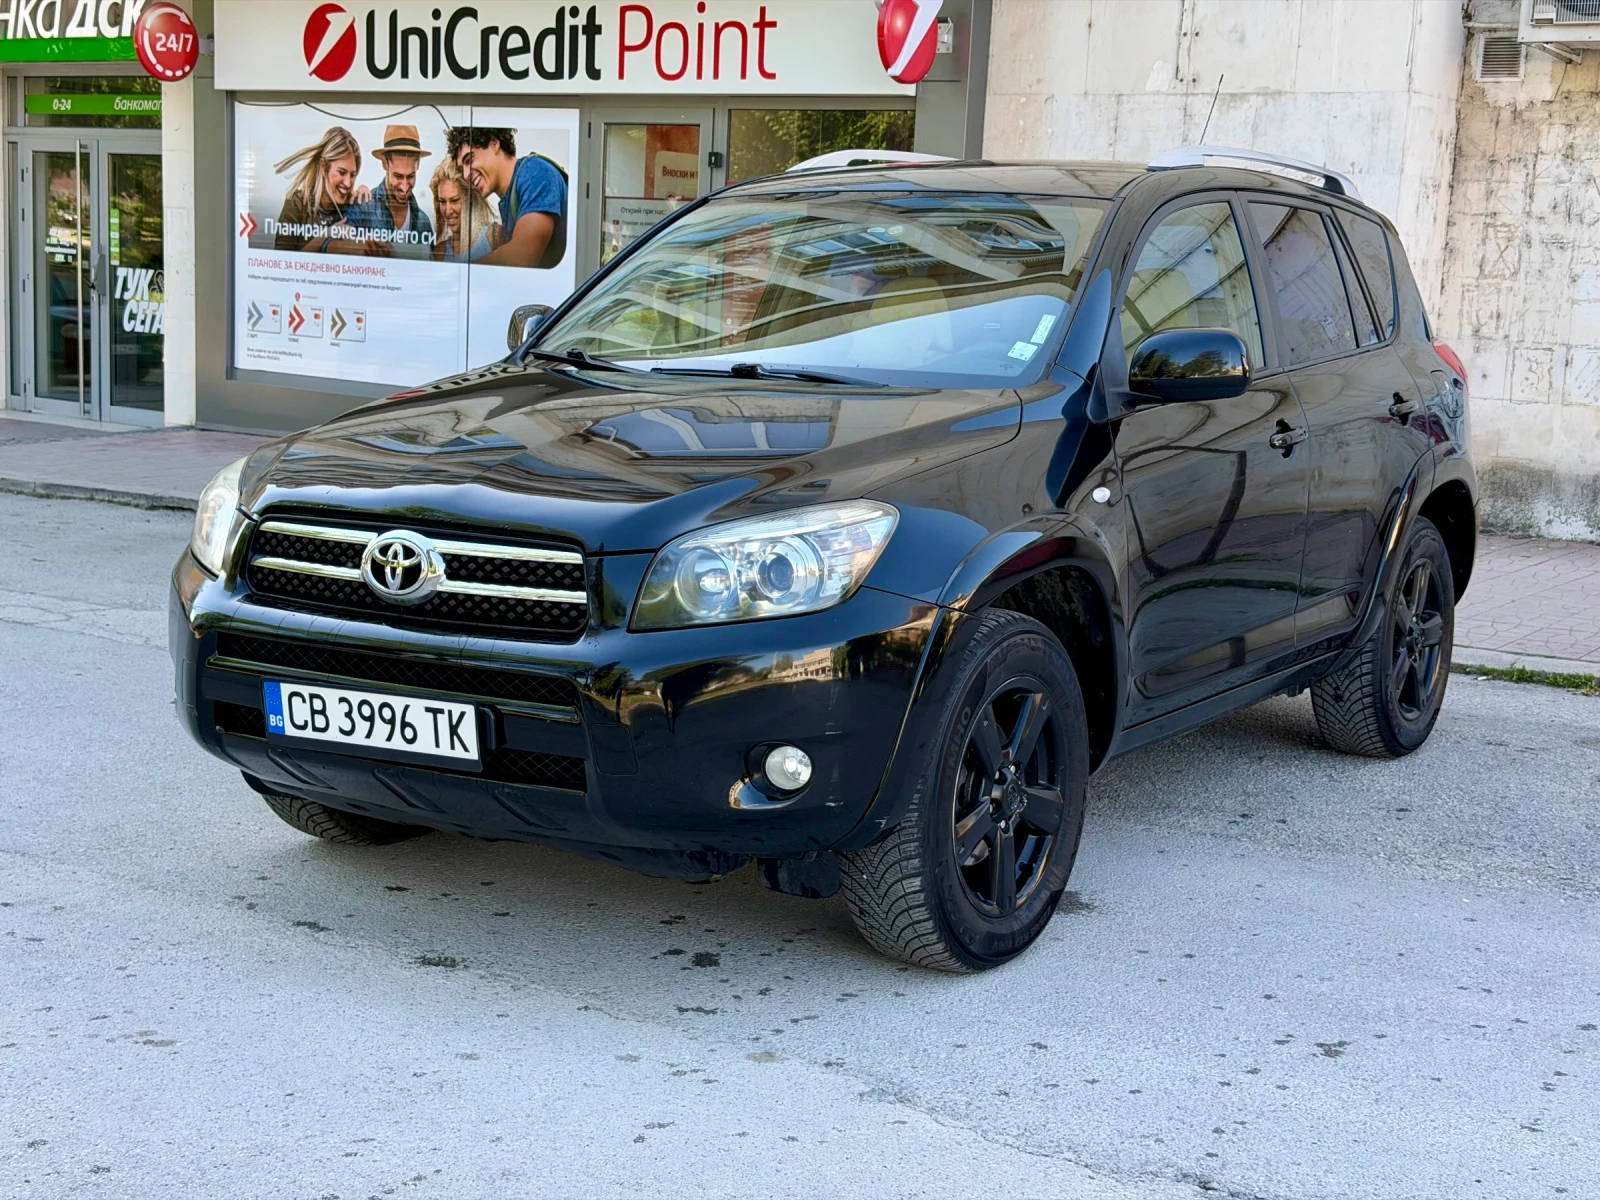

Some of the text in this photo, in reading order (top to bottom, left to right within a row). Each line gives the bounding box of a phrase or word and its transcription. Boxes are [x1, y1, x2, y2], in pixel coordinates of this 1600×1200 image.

[155, 33, 193, 53] 24/7
[366, 1, 778, 81] UniCredit Point
[52, 98, 72, 111] 0-24
[662, 165, 689, 178] Вноски
[264, 217, 437, 246] Планирай ежедневието си
[247, 257, 386, 277] ПЛАНОВЕ ЗА ЕЖЕДНЕВНО БАНКИРАНЕ
[114, 267, 155, 301] ТУК
[269, 713, 284, 728] BG
[287, 690, 471, 754] CB 3996 TK
